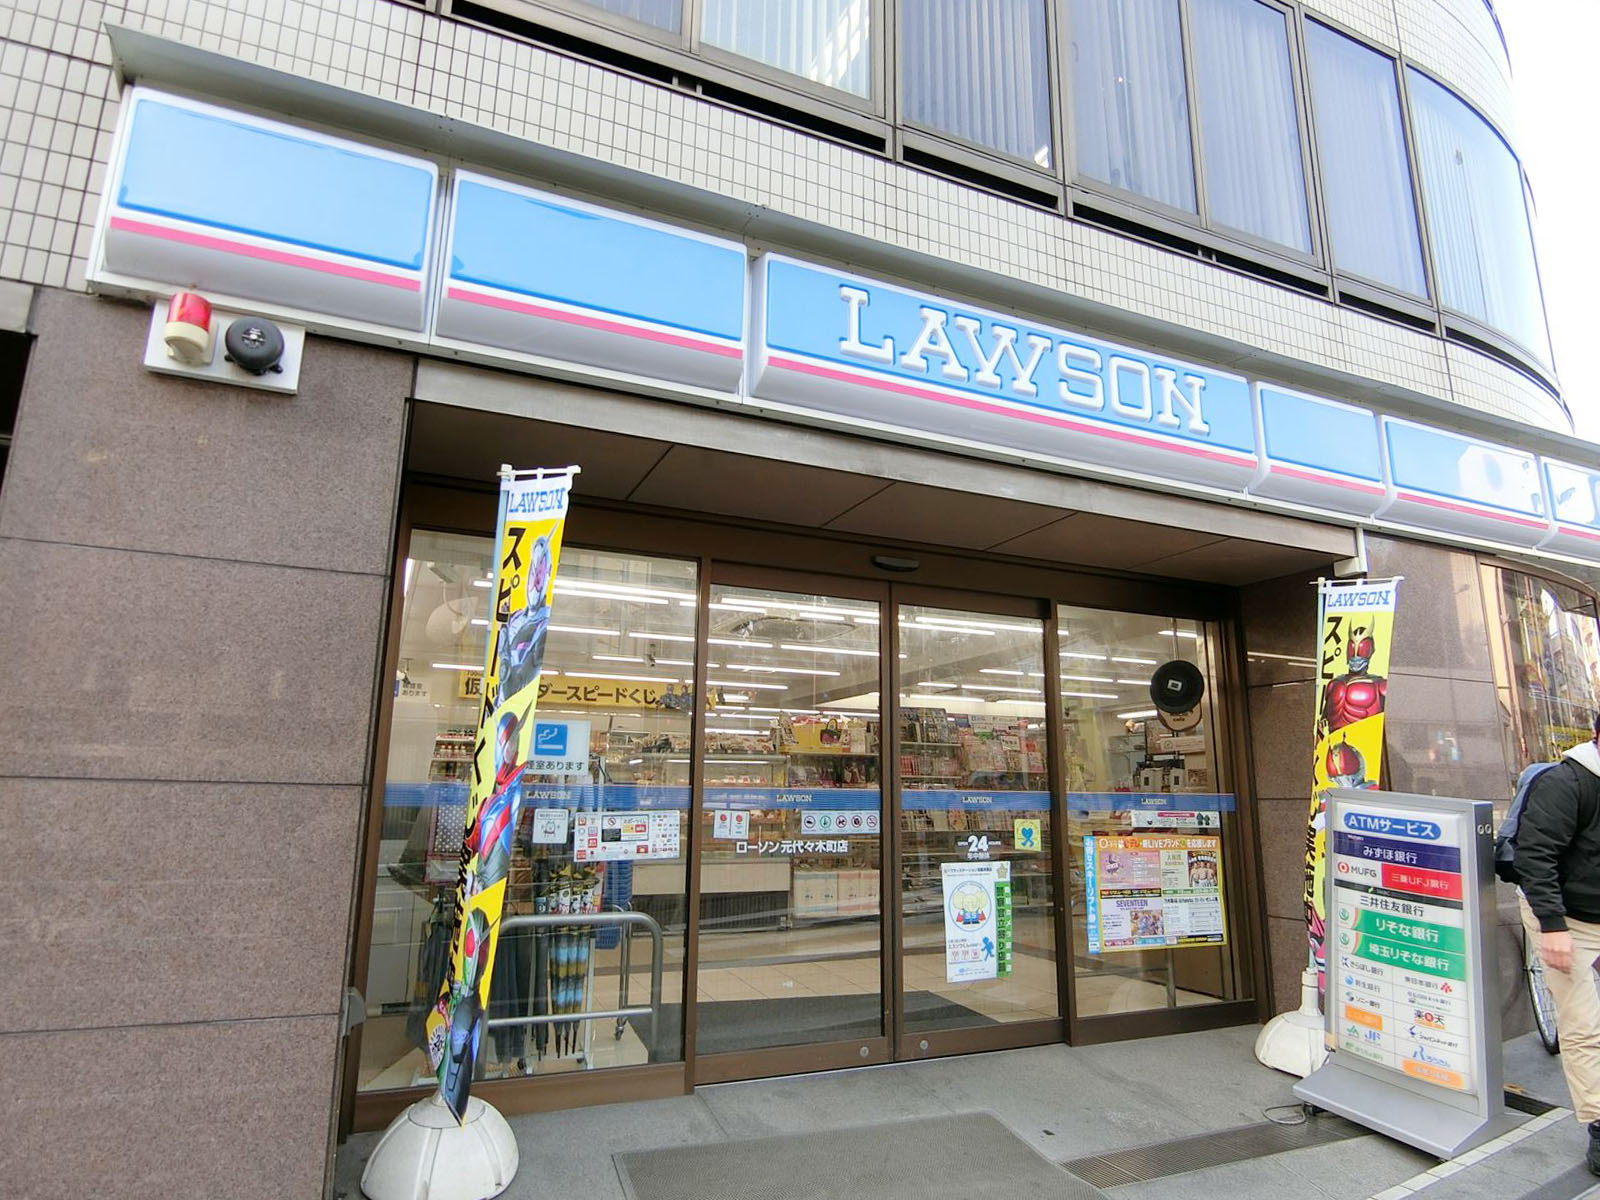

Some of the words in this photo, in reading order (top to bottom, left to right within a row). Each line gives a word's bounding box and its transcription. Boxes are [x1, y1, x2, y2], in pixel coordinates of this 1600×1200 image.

[839, 286, 1209, 436] LAWSON
[508, 487, 566, 513] LAWSON
[1327, 590, 1391, 607] LAWSON
[526, 760, 585, 773] 煙室あります
[526, 791, 571, 799] LAWSON
[776, 794, 813, 803] LAWSON
[962, 796, 993, 804] LAWSON
[1141, 798, 1167, 806] LAWSON
[1348, 815, 1436, 838] ATMサービス
[736, 840, 849, 855] ローソン元代々木町店
[967, 835, 989, 852] 24
[1362, 845, 1418, 864] みずほ銀行
[1351, 865, 1377, 878] MUFG
[1391, 872, 1449, 890] 三菱UFJ銀行
[1116, 899, 1148, 908] SEVENTEEN
[1360, 895, 1425, 917] 三井住友銀行
[1375, 918, 1439, 943] りそな銀行
[1368, 942, 1450, 972] 埼玉りそな銀行
